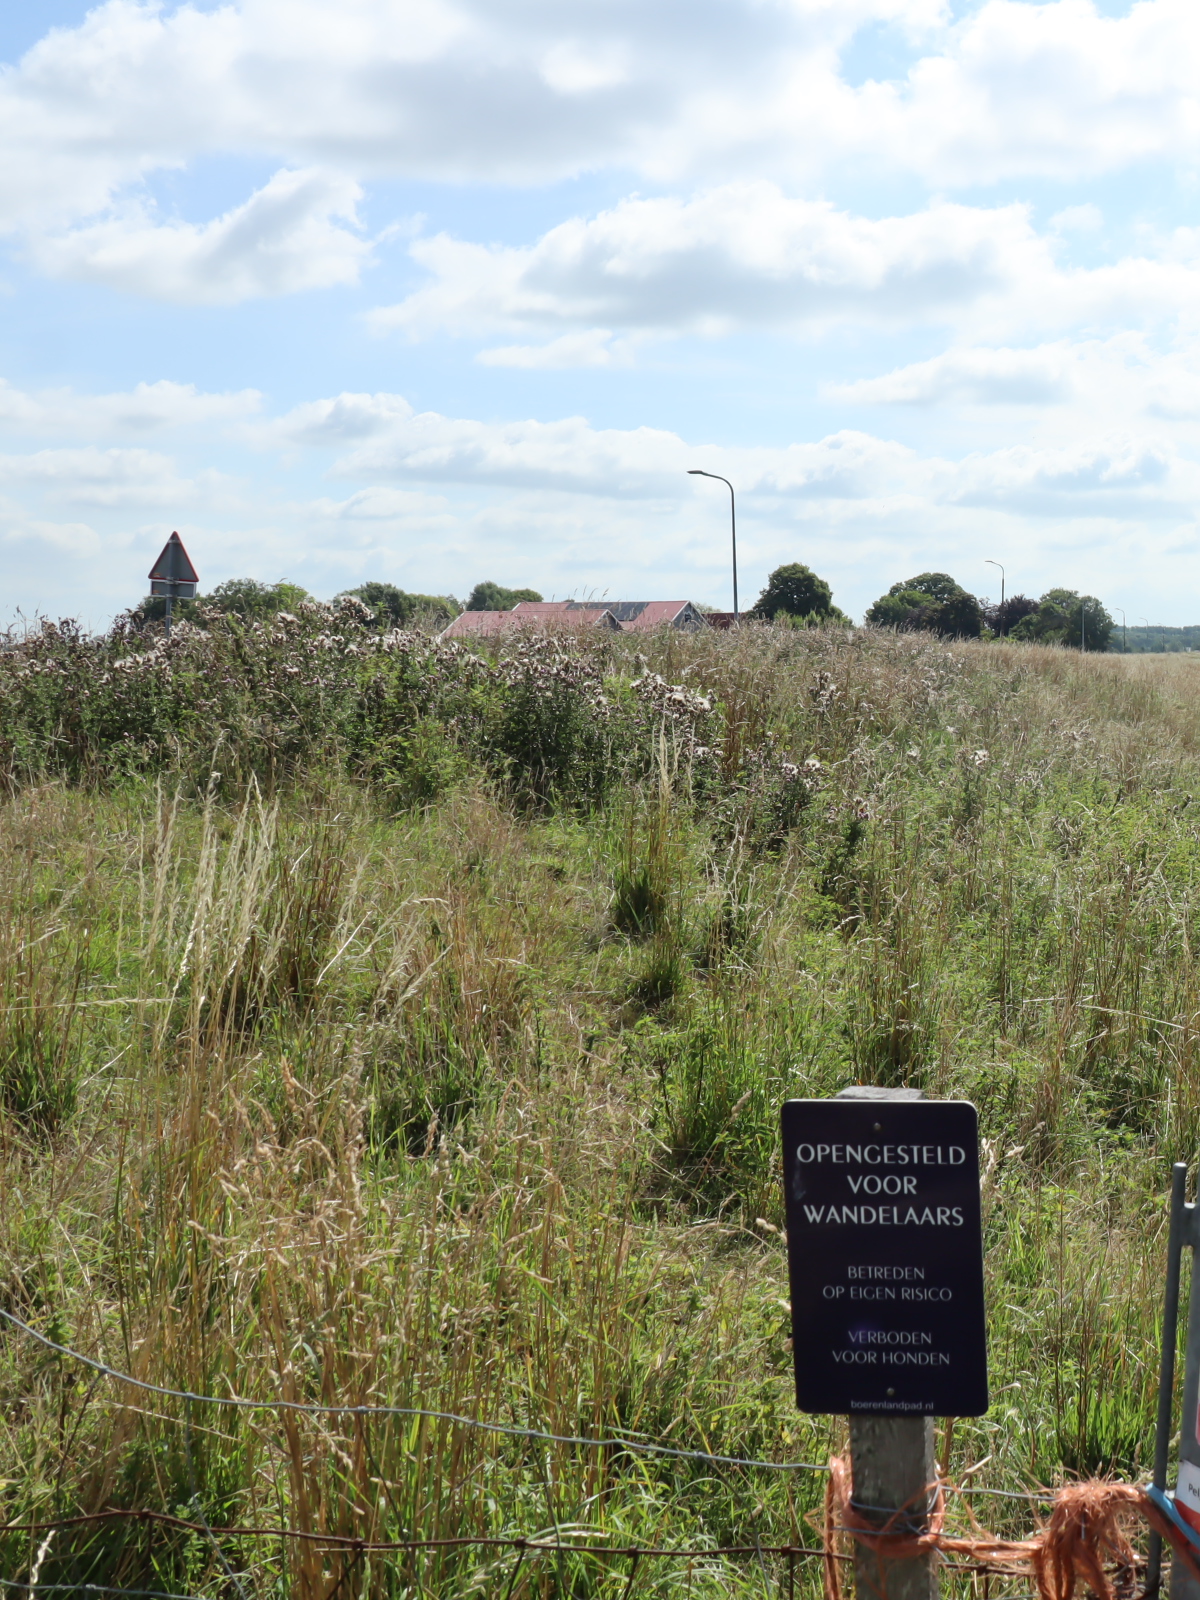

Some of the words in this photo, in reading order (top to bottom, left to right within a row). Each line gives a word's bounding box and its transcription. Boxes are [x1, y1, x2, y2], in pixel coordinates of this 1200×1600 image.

[796, 1144, 966, 1165] OPENGESTELD
[847, 1175, 917, 1195] VOOR
[803, 1205, 964, 1226] WANDELAARS
[848, 1266, 925, 1280] BETREDEN
[822, 1285, 844, 1299] OP
[850, 1286, 896, 1300] EIGEN
[901, 1288, 952, 1301] RISICO
[848, 1330, 932, 1345] VERBODEN
[832, 1350, 877, 1364] VOOR
[882, 1352, 950, 1366] HONDEN
[850, 1400, 934, 1411] boerenlandpad.nl
